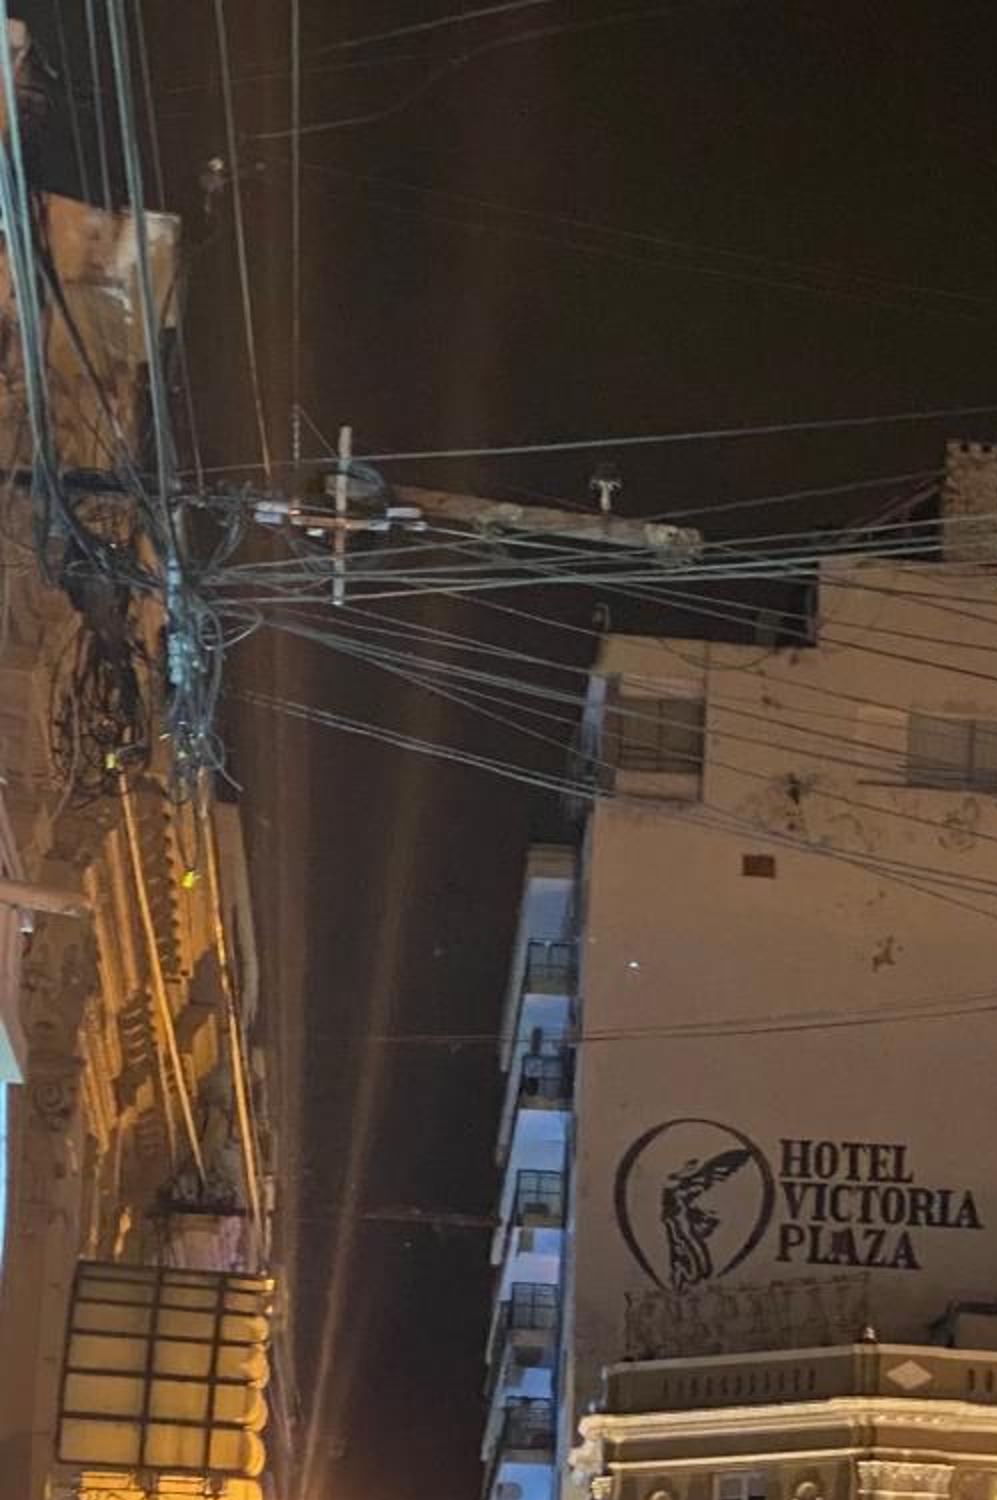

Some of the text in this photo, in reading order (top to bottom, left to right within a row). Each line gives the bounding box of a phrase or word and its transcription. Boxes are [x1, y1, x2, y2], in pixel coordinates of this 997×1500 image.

[778, 1138, 914, 1184] HOTEL
[781, 1182, 984, 1230] VICTORIA
[775, 1224, 921, 1270] PLAZA
